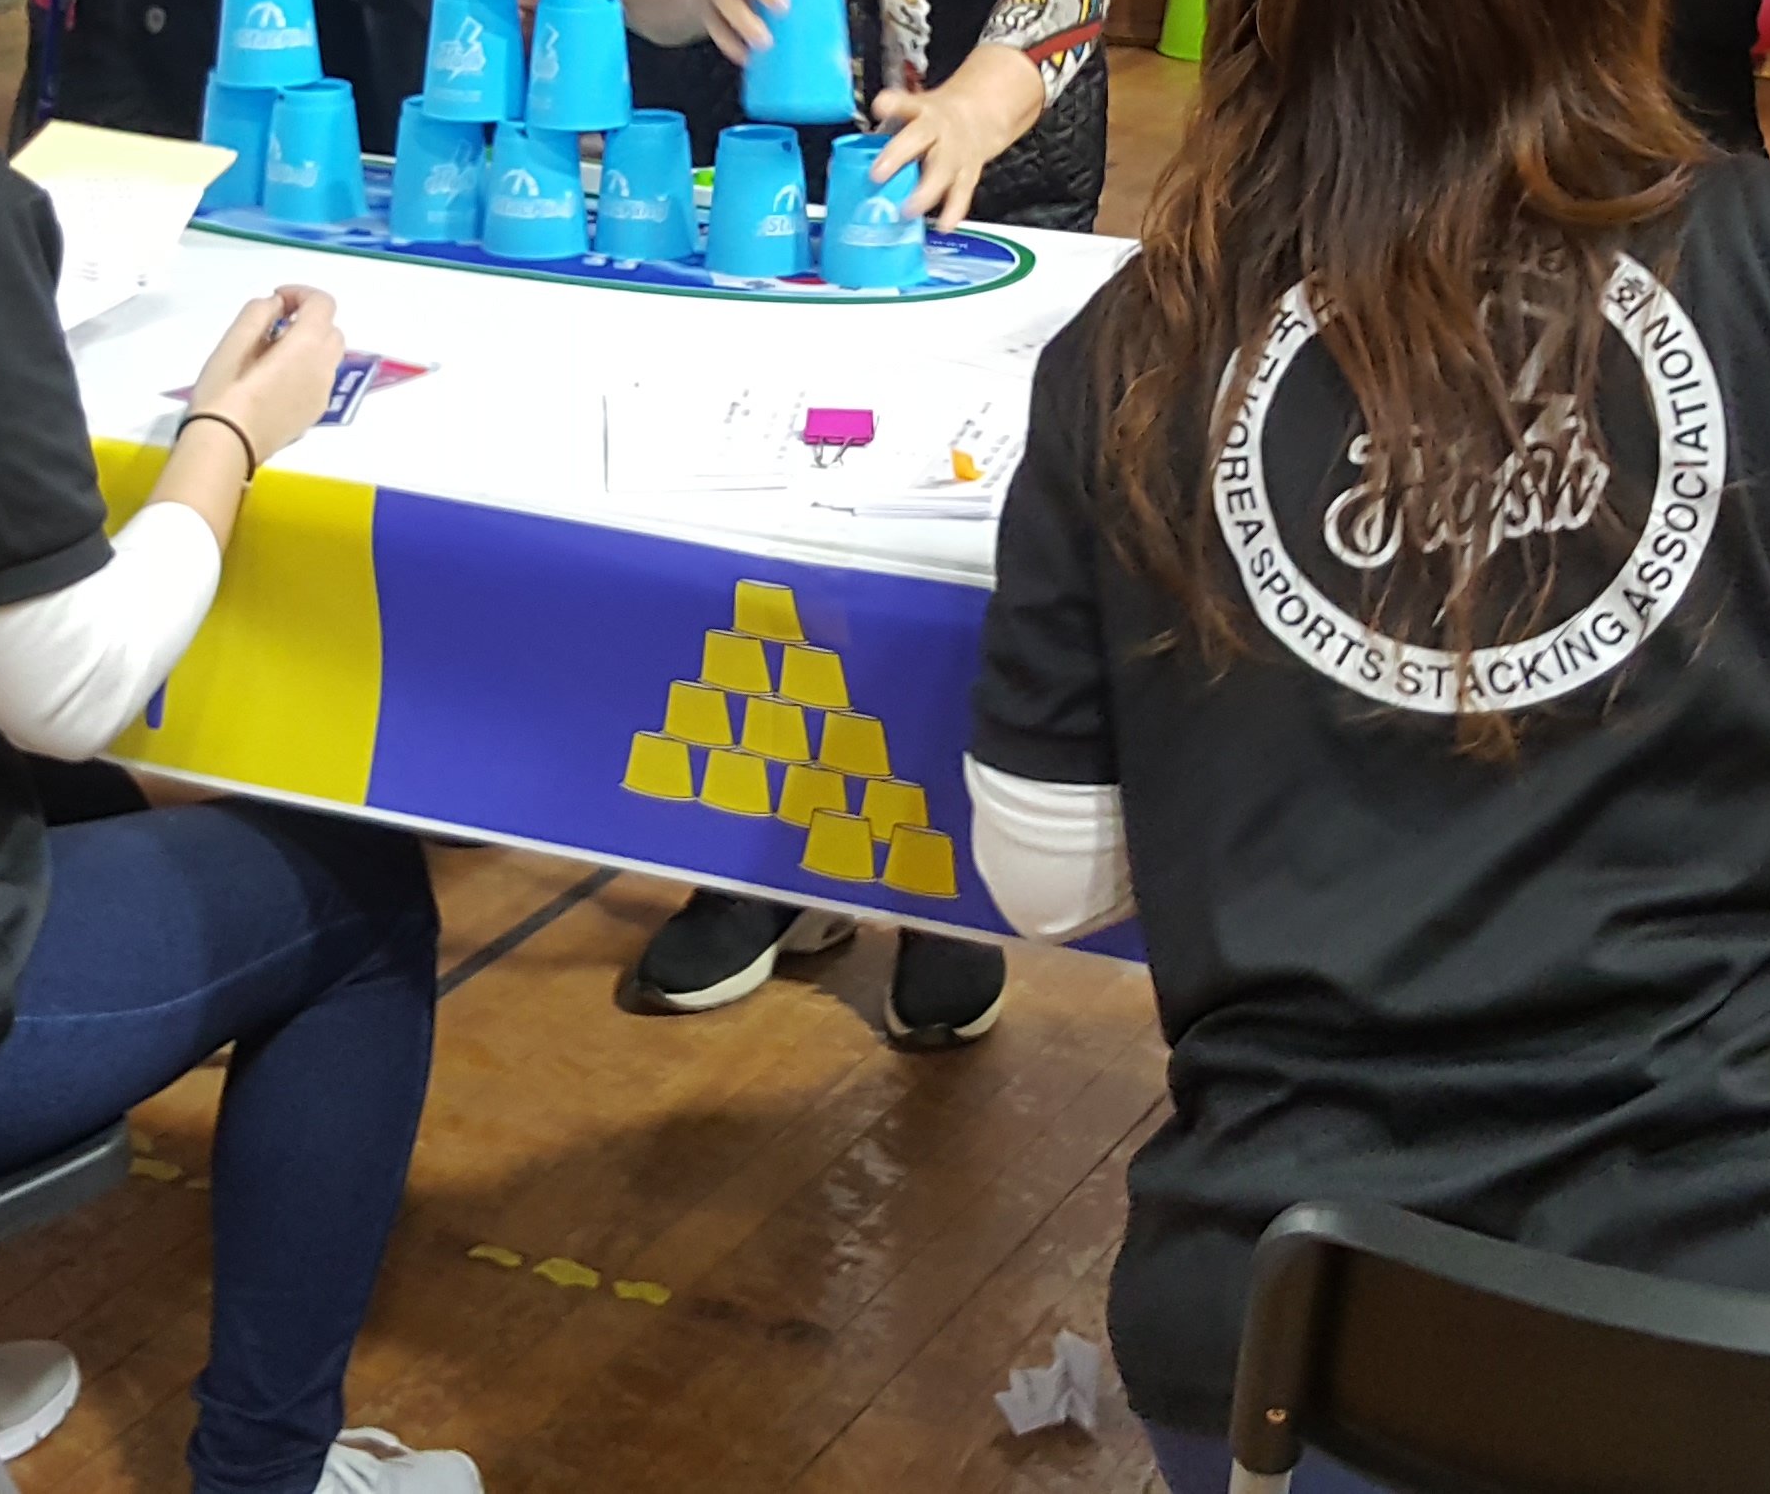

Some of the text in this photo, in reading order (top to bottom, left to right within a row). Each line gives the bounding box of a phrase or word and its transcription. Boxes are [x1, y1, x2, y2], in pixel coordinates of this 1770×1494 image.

[1247, 551, 1384, 682] SPORTS
[1396, 611, 1629, 698] STACKING
[1623, 316, 1709, 621] ASSOCIATION
